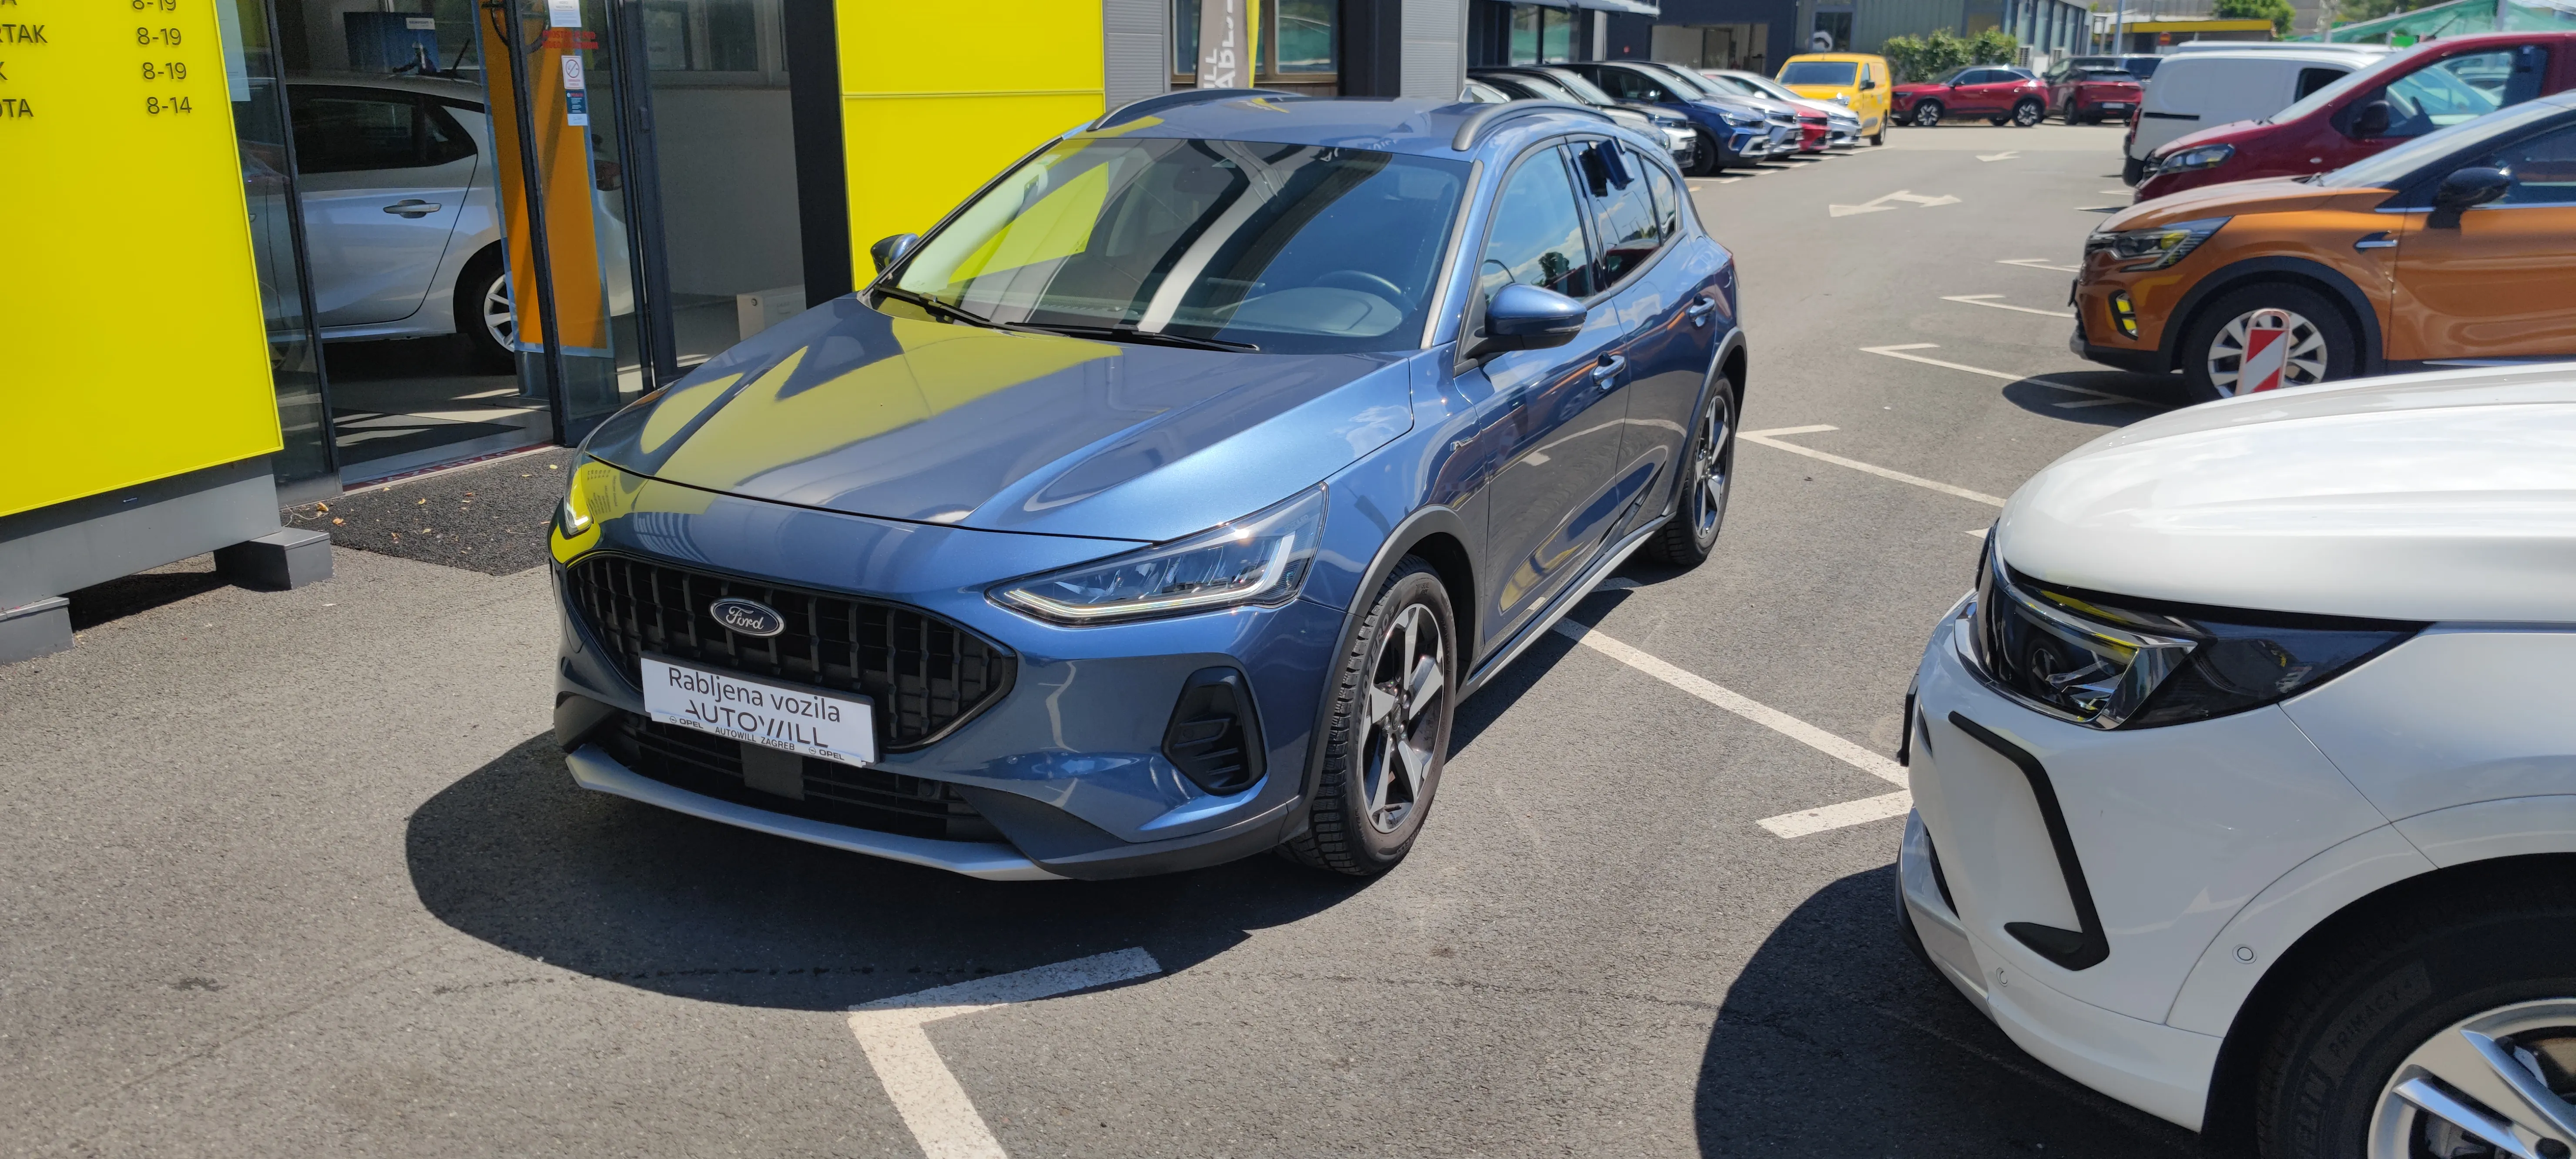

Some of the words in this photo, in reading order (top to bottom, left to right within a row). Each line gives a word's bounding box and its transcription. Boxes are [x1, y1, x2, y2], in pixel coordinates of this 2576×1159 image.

[137, 27, 181, 45] 8-19
[143, 62, 187, 80] 8-19
[0, 98, 34, 117] TA
[147, 96, 192, 114] 8-14
[726, 606, 764, 630] Ford
[668, 667, 763, 707] Rabljena
[770, 693, 840, 723] vozila
[685, 699, 828, 748] AUTOWILL
[679, 718, 704, 729] OPEL
[715, 727, 757, 743] AUTOWILL
[761, 736, 795, 751] ZAGREB
[819, 749, 845, 761] OPEL
